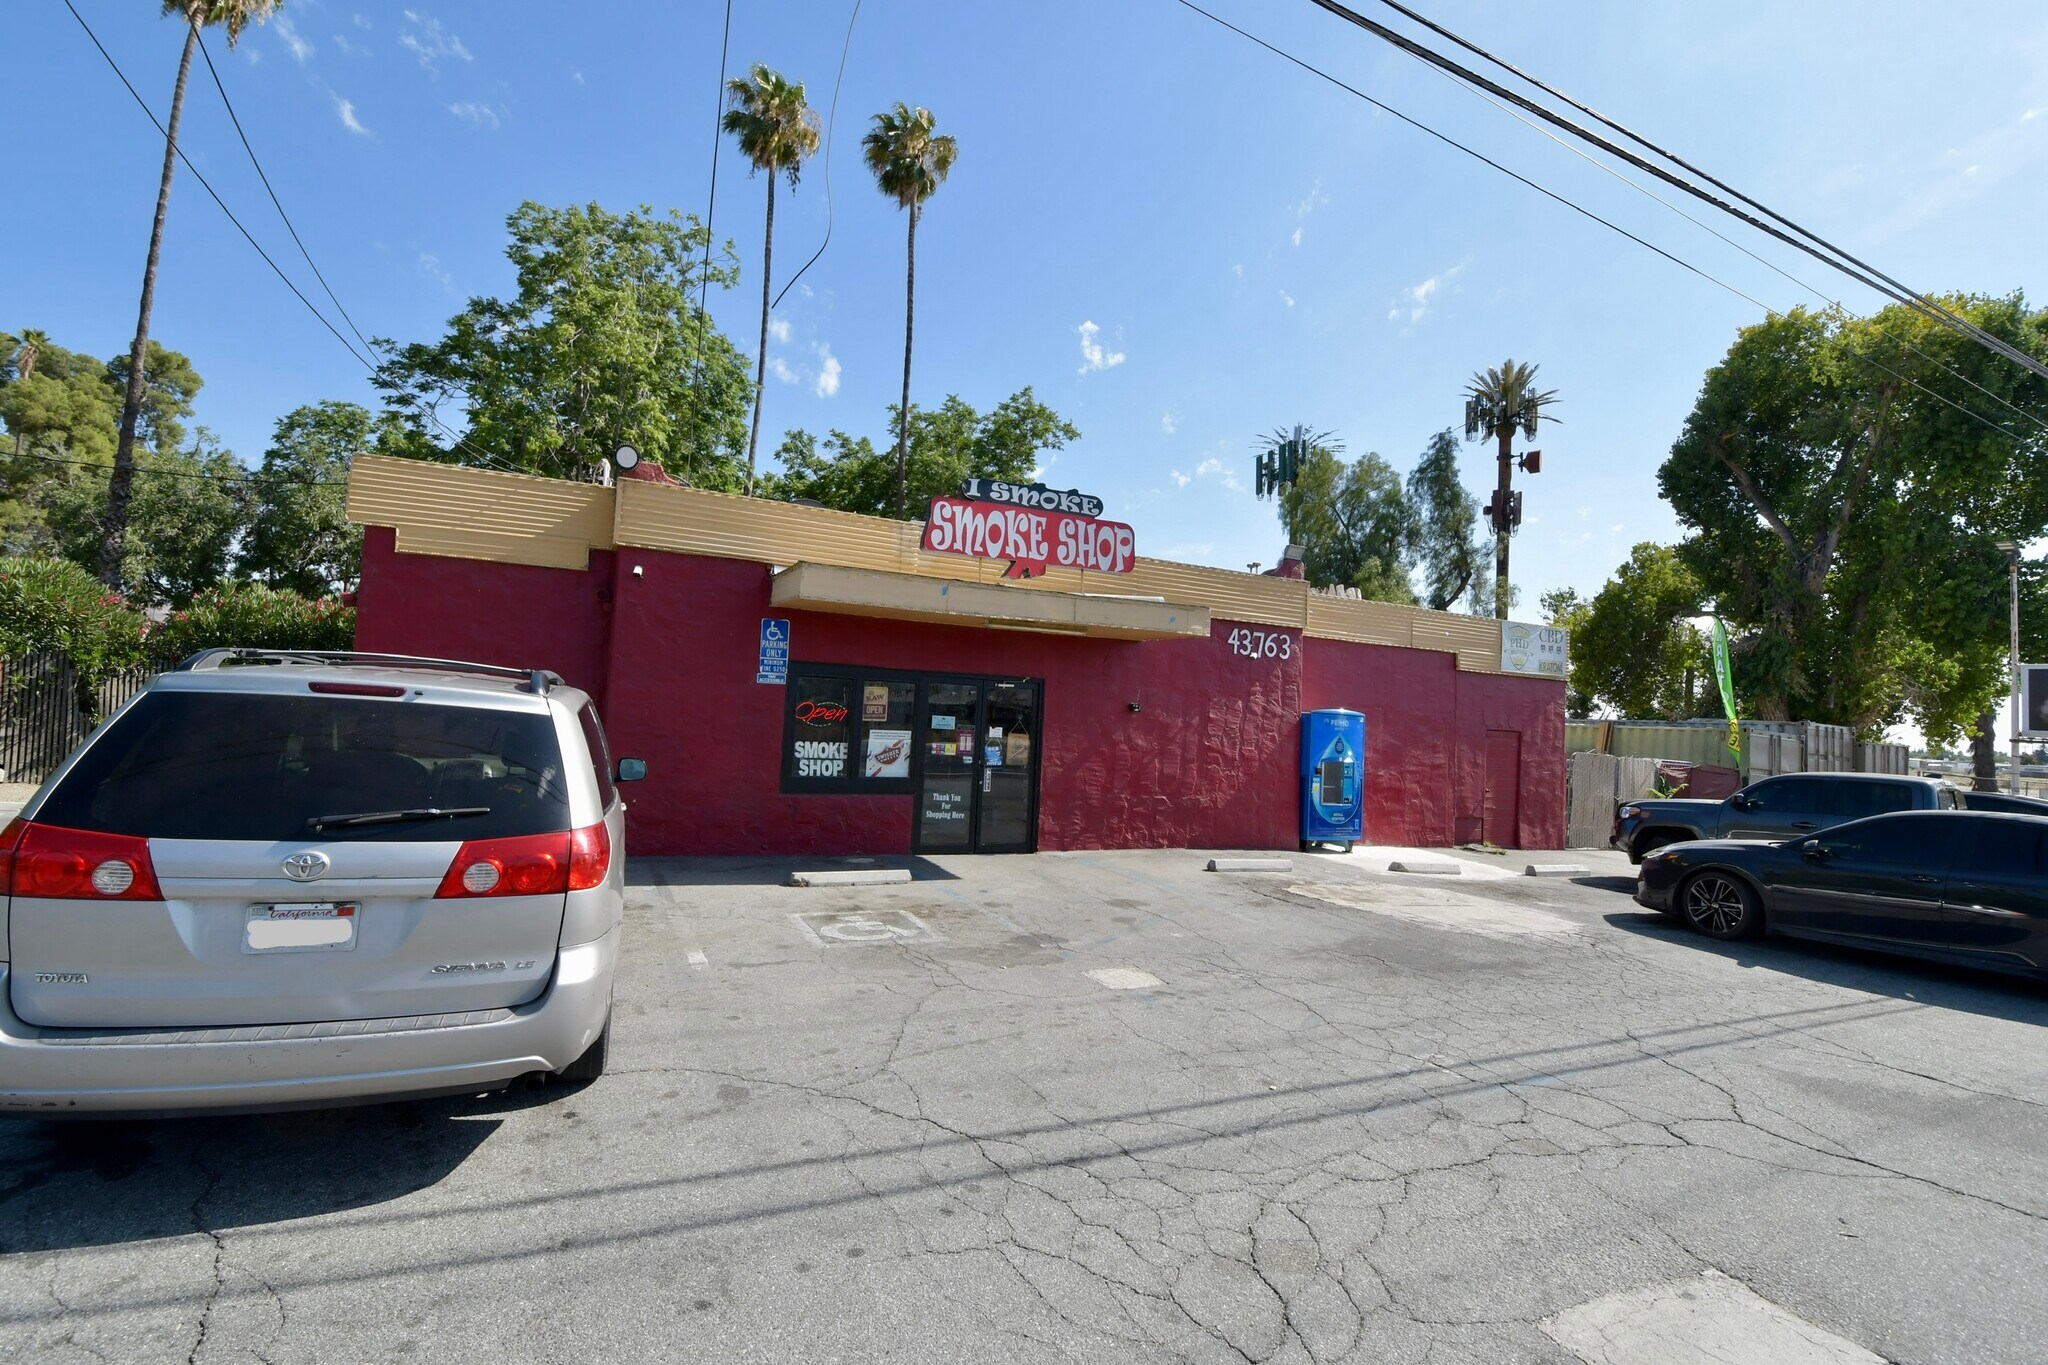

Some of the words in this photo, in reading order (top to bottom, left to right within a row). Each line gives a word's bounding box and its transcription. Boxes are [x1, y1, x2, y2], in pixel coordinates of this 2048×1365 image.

[966, 478, 981, 497] I
[990, 482, 1100, 516] SMOKE
[930, 500, 1049, 561] SMOKE
[1056, 518, 1134, 573] SHOP
[1539, 628, 1564, 644] CBD
[761, 640, 788, 649] PARKING
[1227, 628, 1291, 660] 43763
[1510, 637, 1530, 649] PHD
[766, 649, 783, 658] ONLY
[866, 694, 885, 702] RAW
[796, 701, 848, 721] Open
[866, 705, 884, 714] OPEN
[794, 741, 849, 759] SMOKE
[798, 759, 844, 777] SHOP
[932, 793, 950, 801] Thank
[941, 802, 951, 810] For
[925, 810, 951, 819] Shopping
[951, 811, 965, 819] Here
[270, 909, 333, 920] California
[431, 960, 508, 974] SIENNA
[515, 960, 537, 969] LE
[34, 972, 89, 984] TOYOTA
